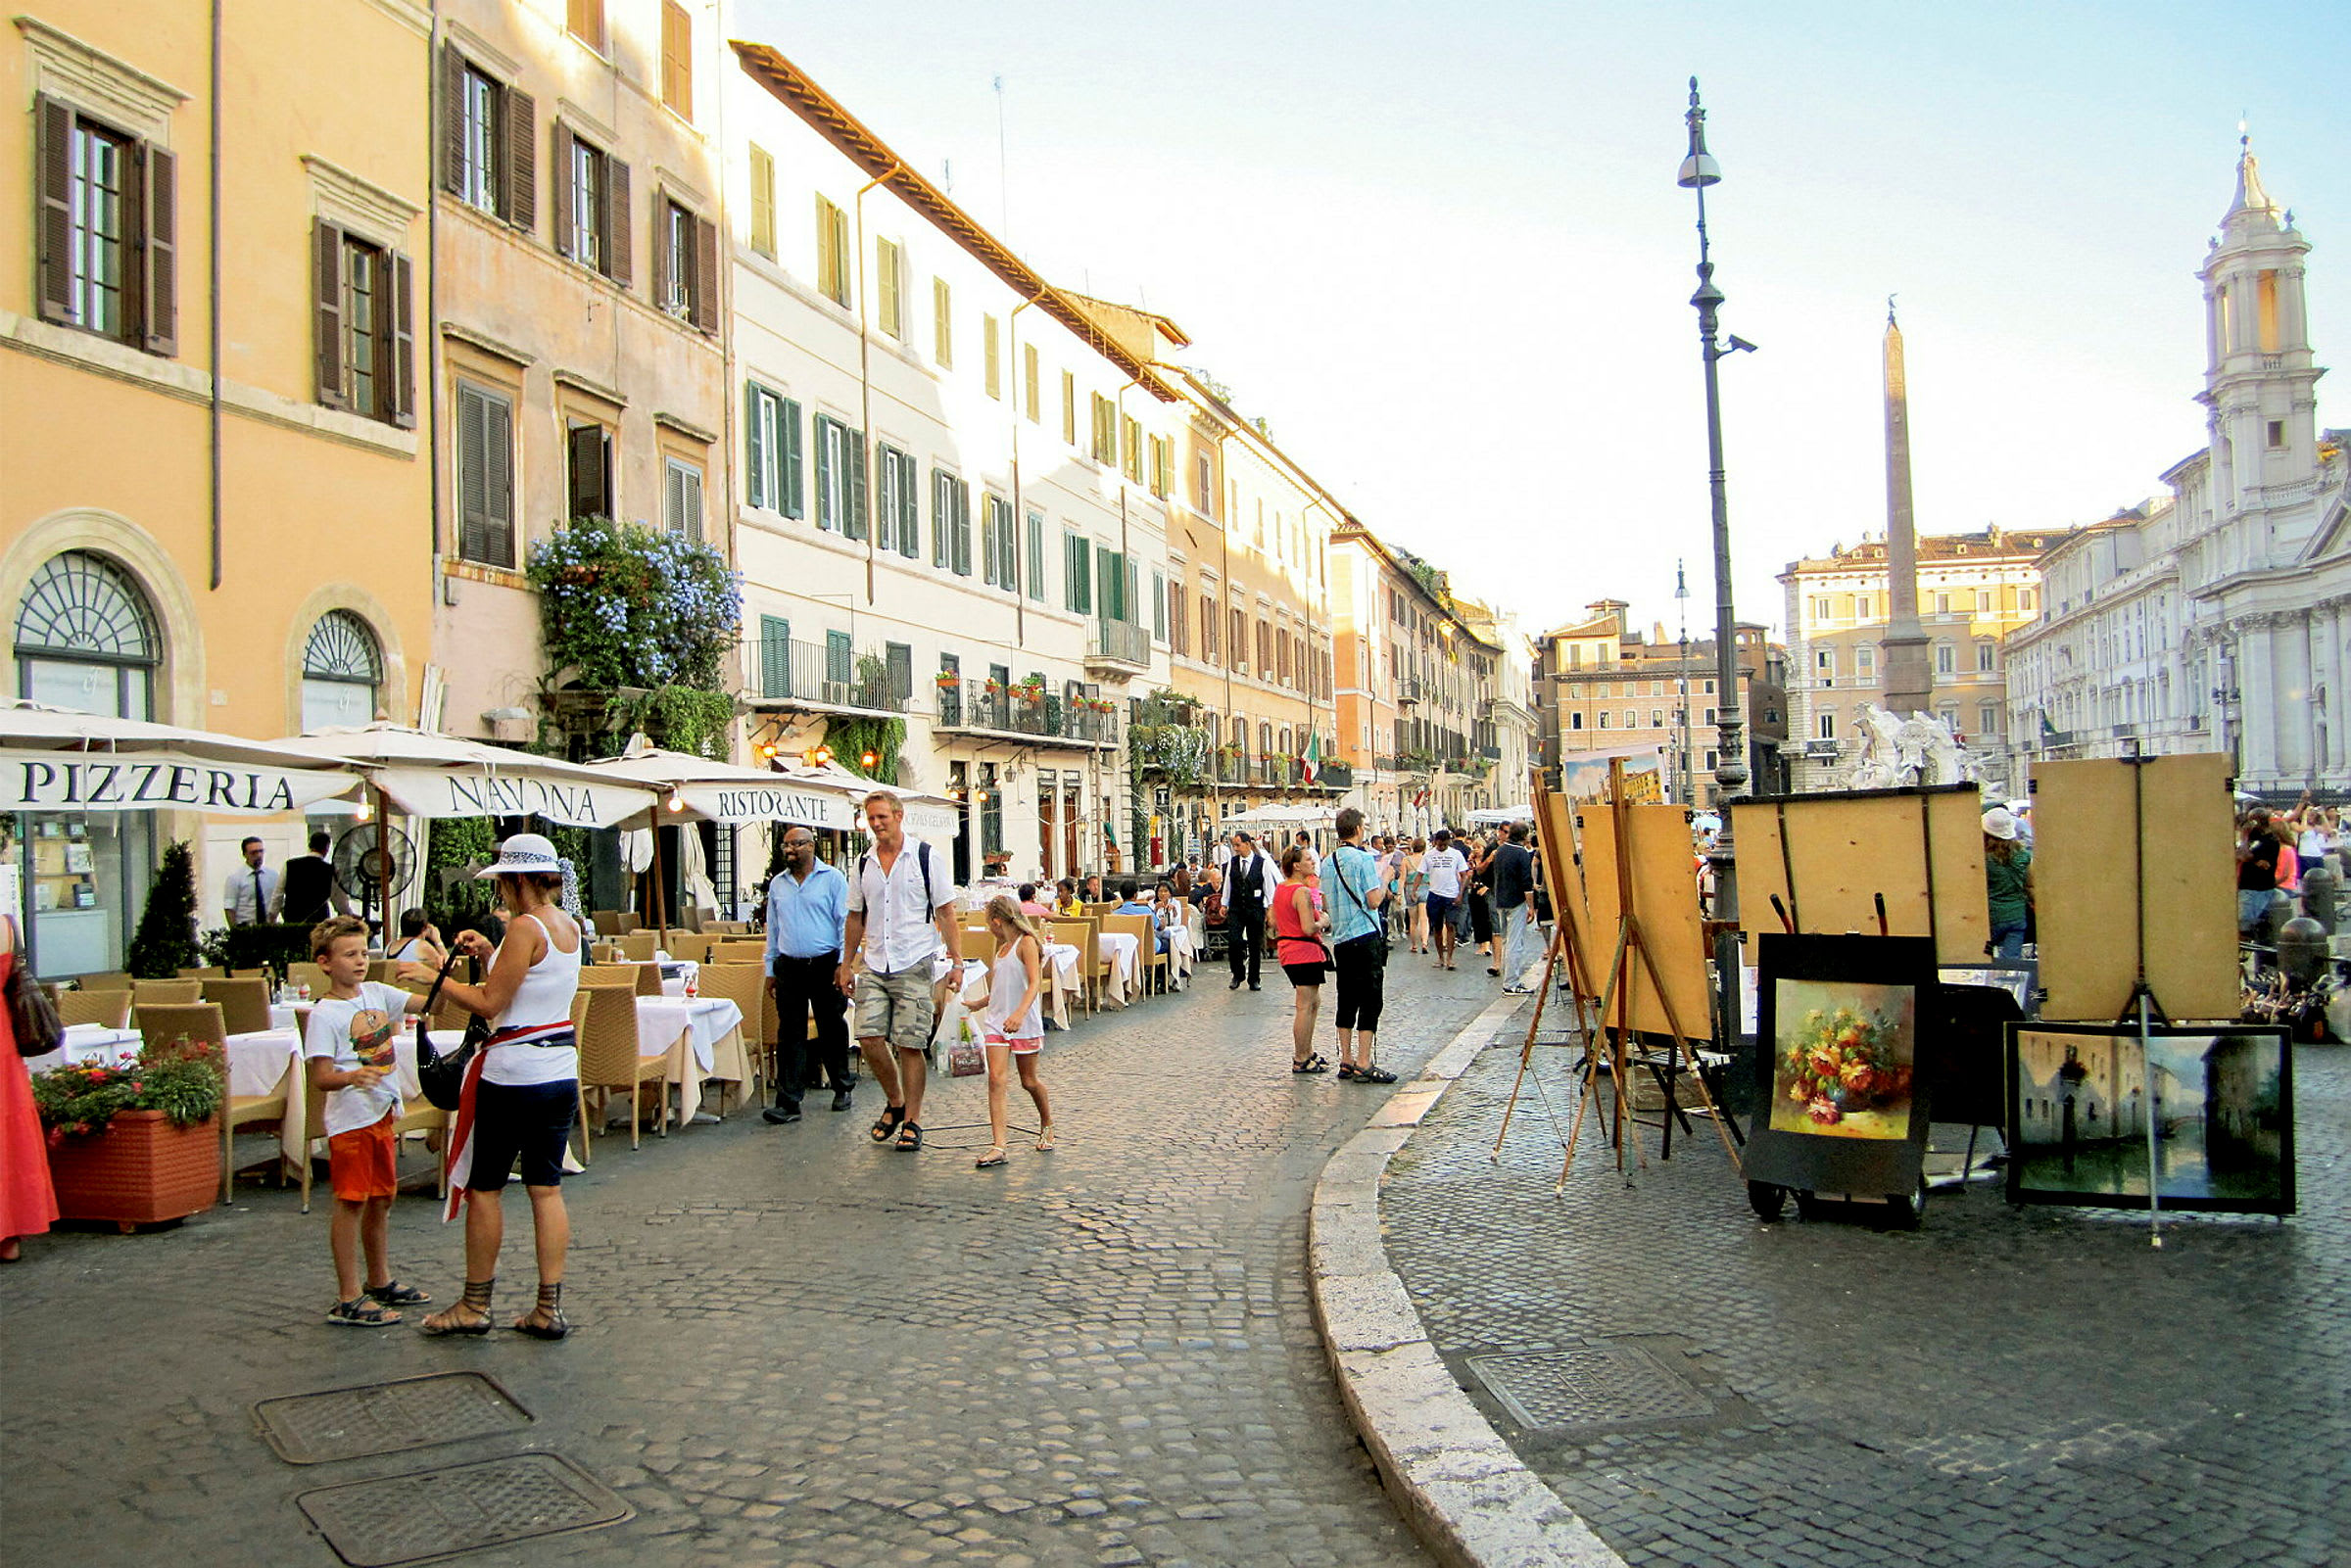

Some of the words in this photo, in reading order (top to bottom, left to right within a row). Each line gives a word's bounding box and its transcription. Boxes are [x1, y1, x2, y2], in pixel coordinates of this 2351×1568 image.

[19, 762, 295, 810] PIZZERIA
[446, 776, 598, 823] NAVONA
[718, 789, 829, 822] RISTORANTE
